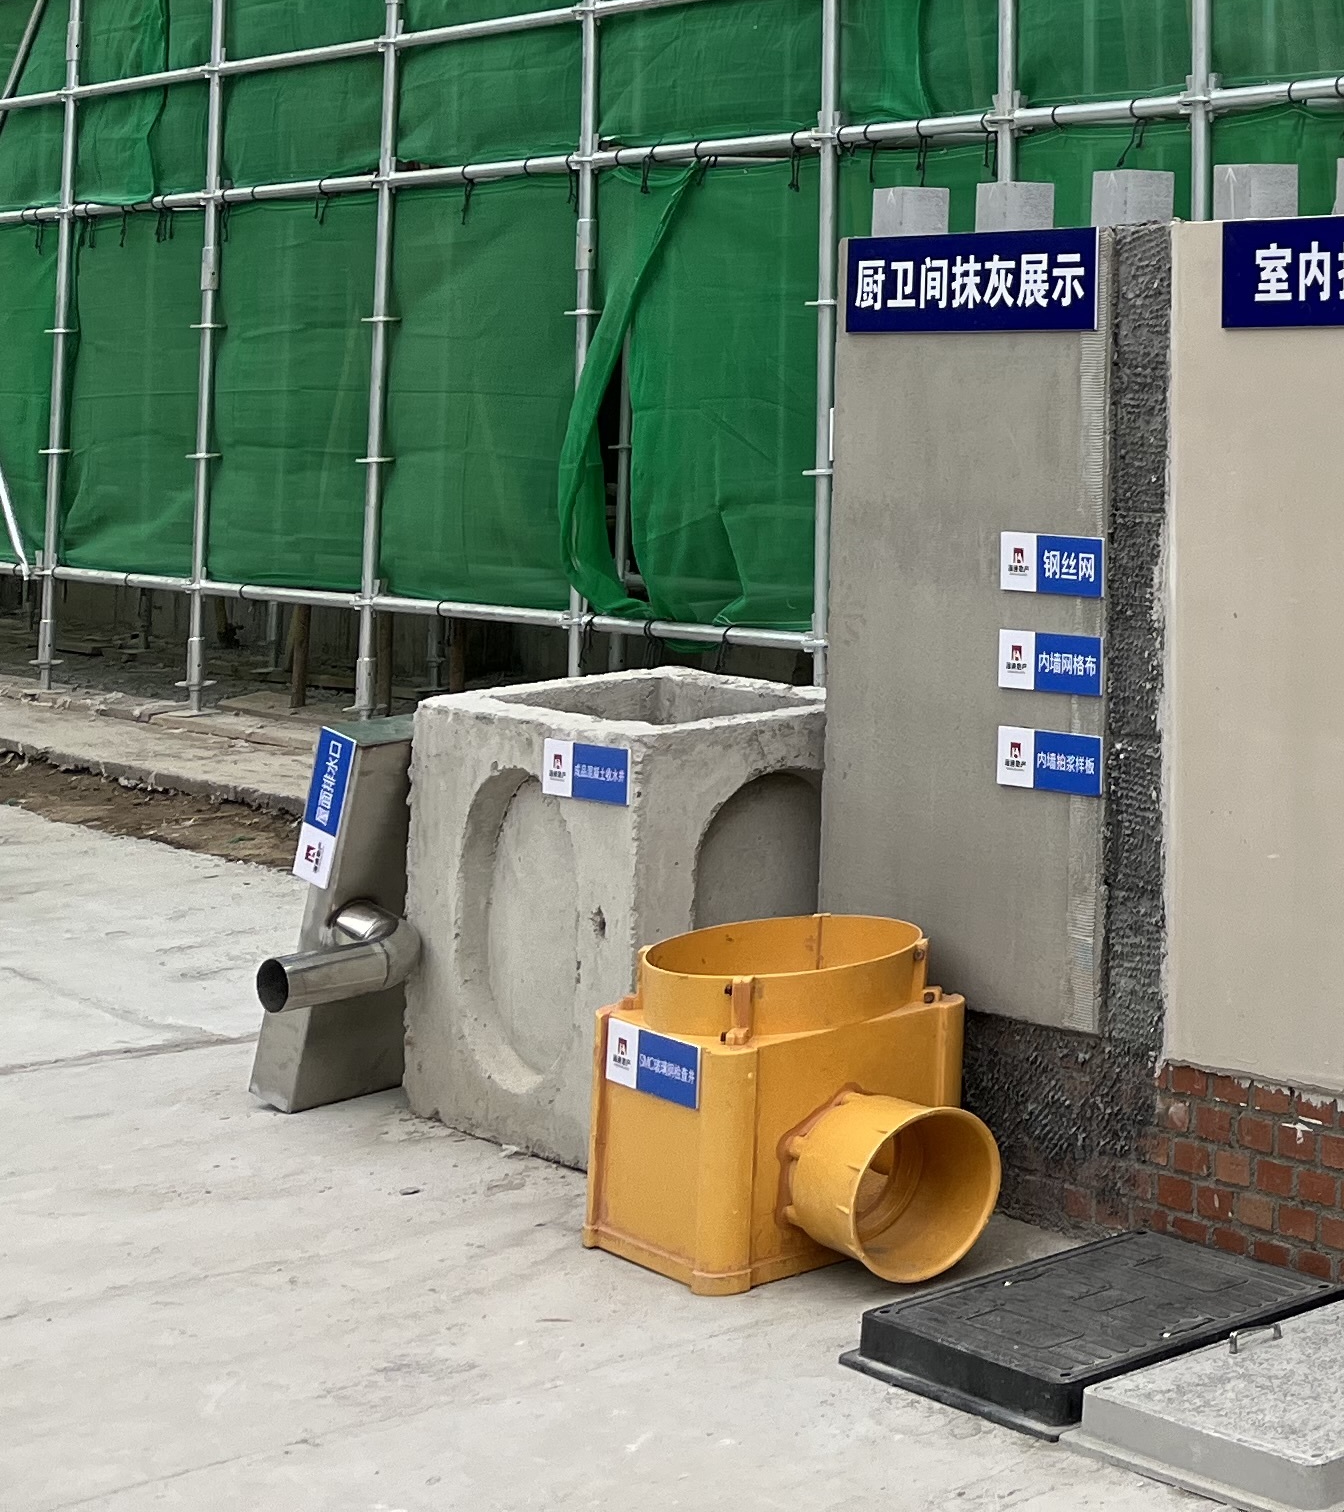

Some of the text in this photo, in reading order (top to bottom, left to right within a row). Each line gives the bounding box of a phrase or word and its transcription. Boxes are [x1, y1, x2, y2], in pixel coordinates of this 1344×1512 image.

[855, 252, 1087, 310] 厨卫间抹灰展示
[1043, 549, 1095, 582] 钢丝网
[1038, 651, 1097, 678] 内墙网格布
